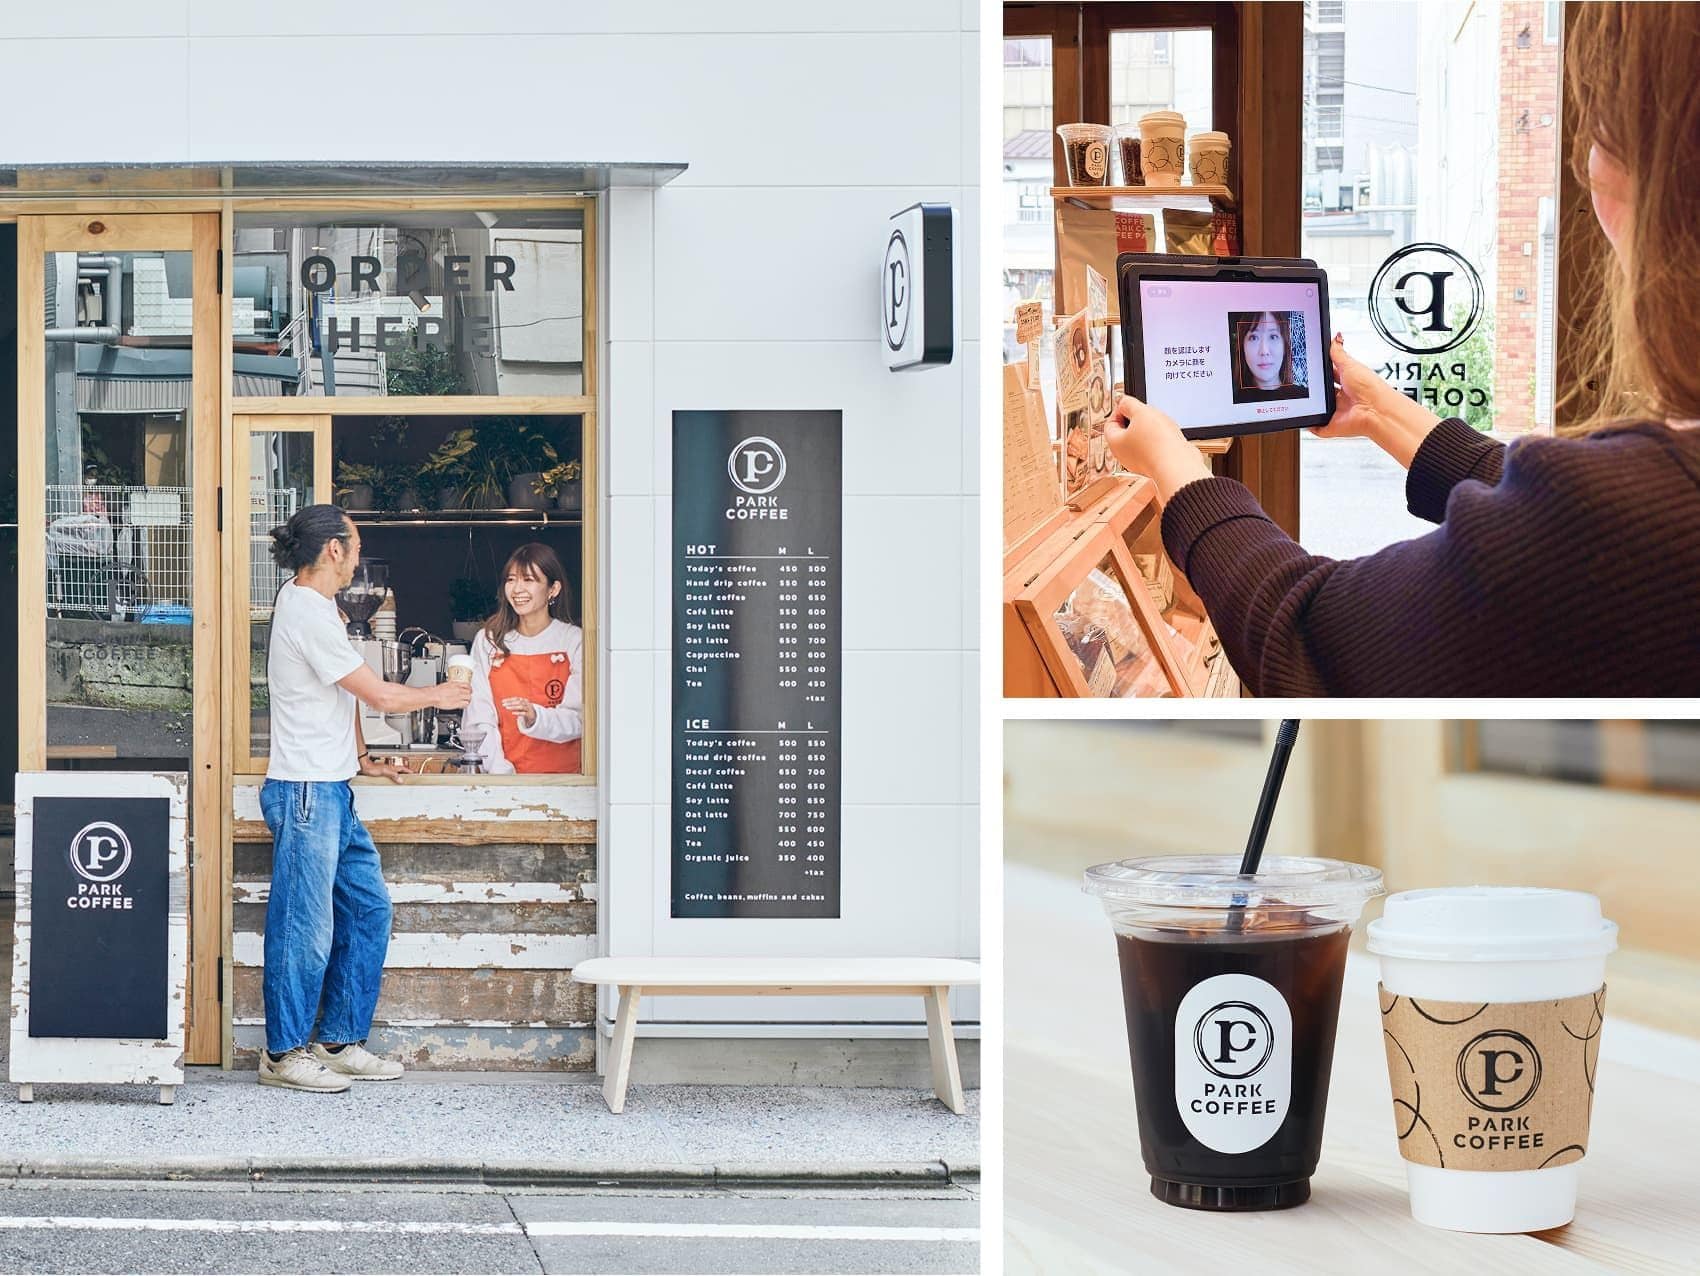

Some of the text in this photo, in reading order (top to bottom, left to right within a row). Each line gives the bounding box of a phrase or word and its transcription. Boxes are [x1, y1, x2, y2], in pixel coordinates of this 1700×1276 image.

[301, 255, 516, 292] ORDER
[328, 316, 491, 352] HERE
[736, 496, 778, 506] PARK
[726, 508, 788, 520] COFFEE
[687, 545, 716, 554] HOT
[808, 547, 814, 555] L
[687, 565, 722, 574] Today's
[727, 565, 756, 573] coffee
[714, 580, 733, 589] drip
[711, 608, 733, 616] latte
[687, 623, 703, 631] Soy
[686, 637, 701, 645] Oat
[706, 637, 728, 645] latte
[686, 651, 740, 661] Cappuccino
[686, 680, 702, 688] Tea
[687, 719, 709, 729] ICE
[686, 740, 722, 748] Today's
[714, 754, 732, 763] drip
[686, 768, 712, 776] Decaf
[716, 768, 745, 776] coffee
[686, 797, 702, 806] Soy
[707, 797, 729, 805] latte
[685, 811, 701, 819] Oat
[706, 811, 728, 819] latte
[685, 854, 721, 863] Organic
[725, 854, 749, 863] juice
[78, 884, 122, 896] PARK
[685, 893, 713, 901] Coffee
[67, 898, 133, 909] COFFEE
[1204, 1084, 1262, 1098] PARK
[1191, 1099, 1276, 1114] COFFEE
[1468, 1116, 1530, 1132] PARK
[1454, 1133, 1544, 1150] COFFEE
